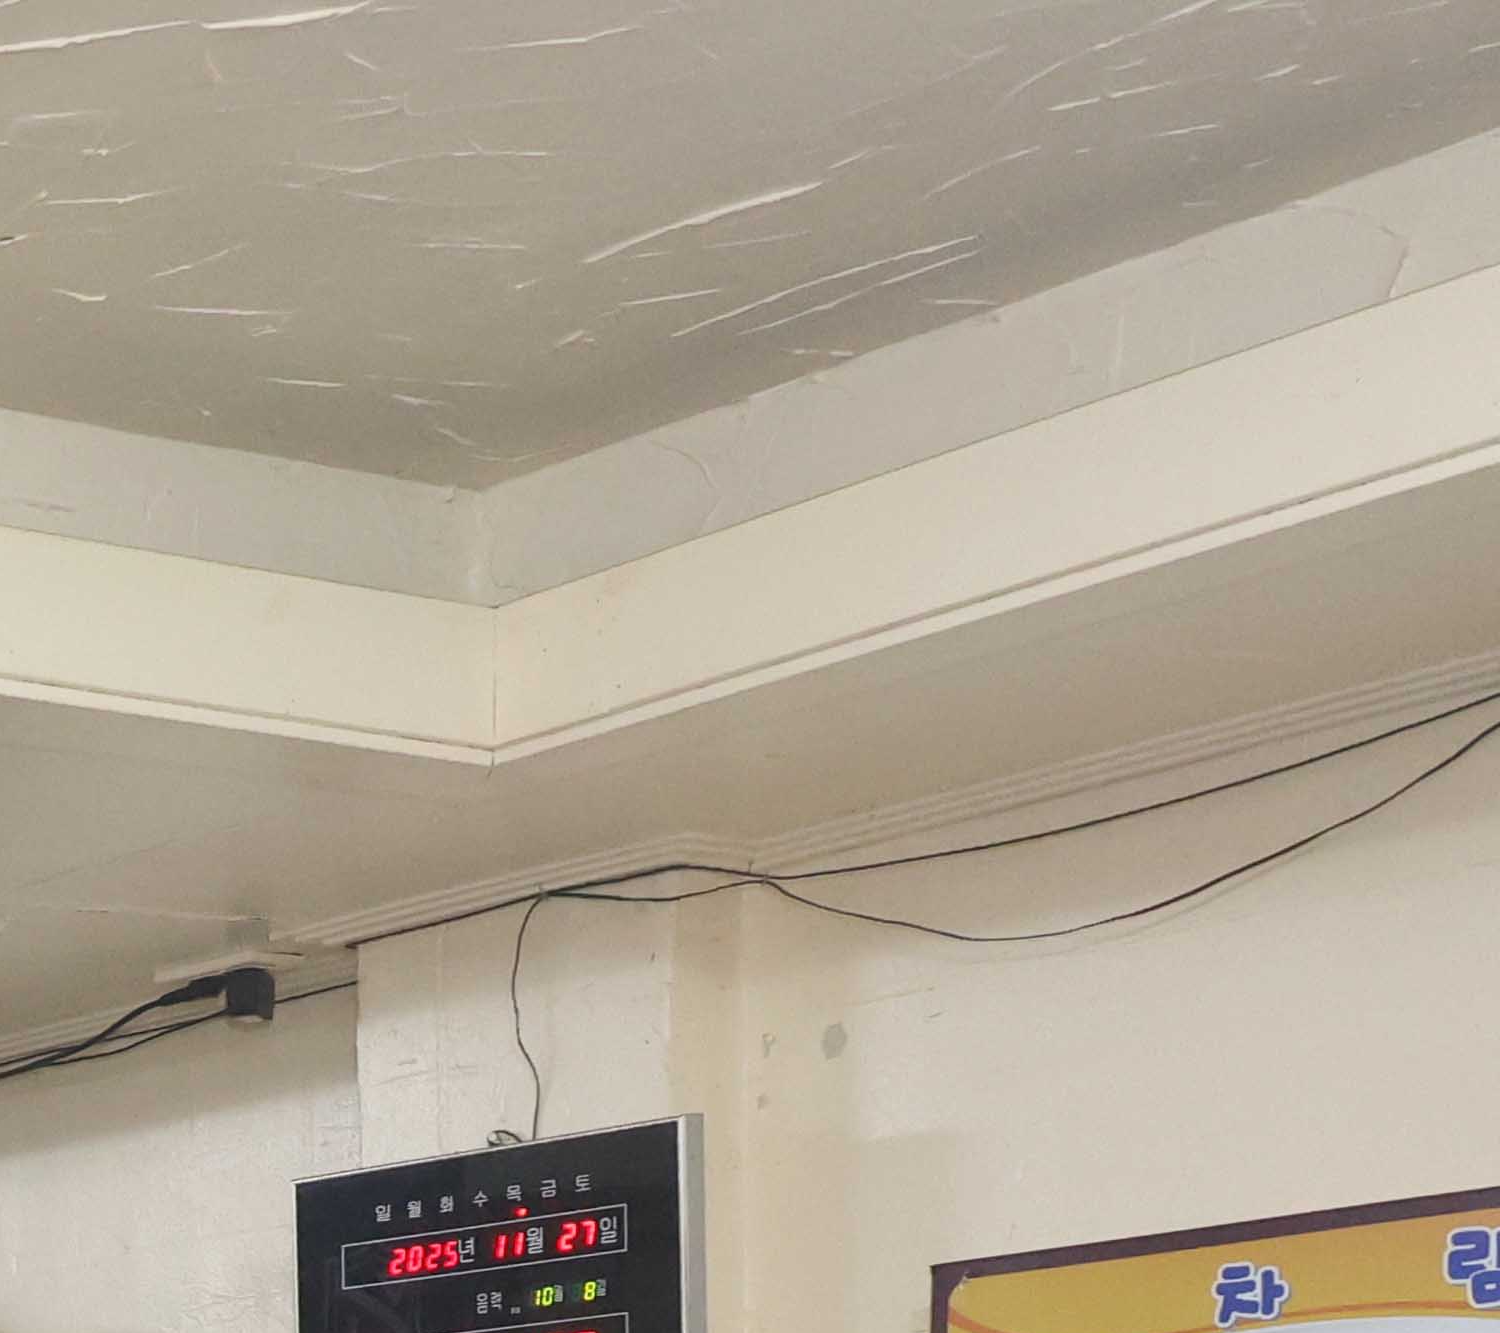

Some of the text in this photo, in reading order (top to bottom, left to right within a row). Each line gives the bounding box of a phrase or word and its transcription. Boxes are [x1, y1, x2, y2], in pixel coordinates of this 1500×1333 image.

[375, 1174, 591, 1222] 일 월 화 수 목 금 토
[1212, 1262, 1290, 1328] 차
